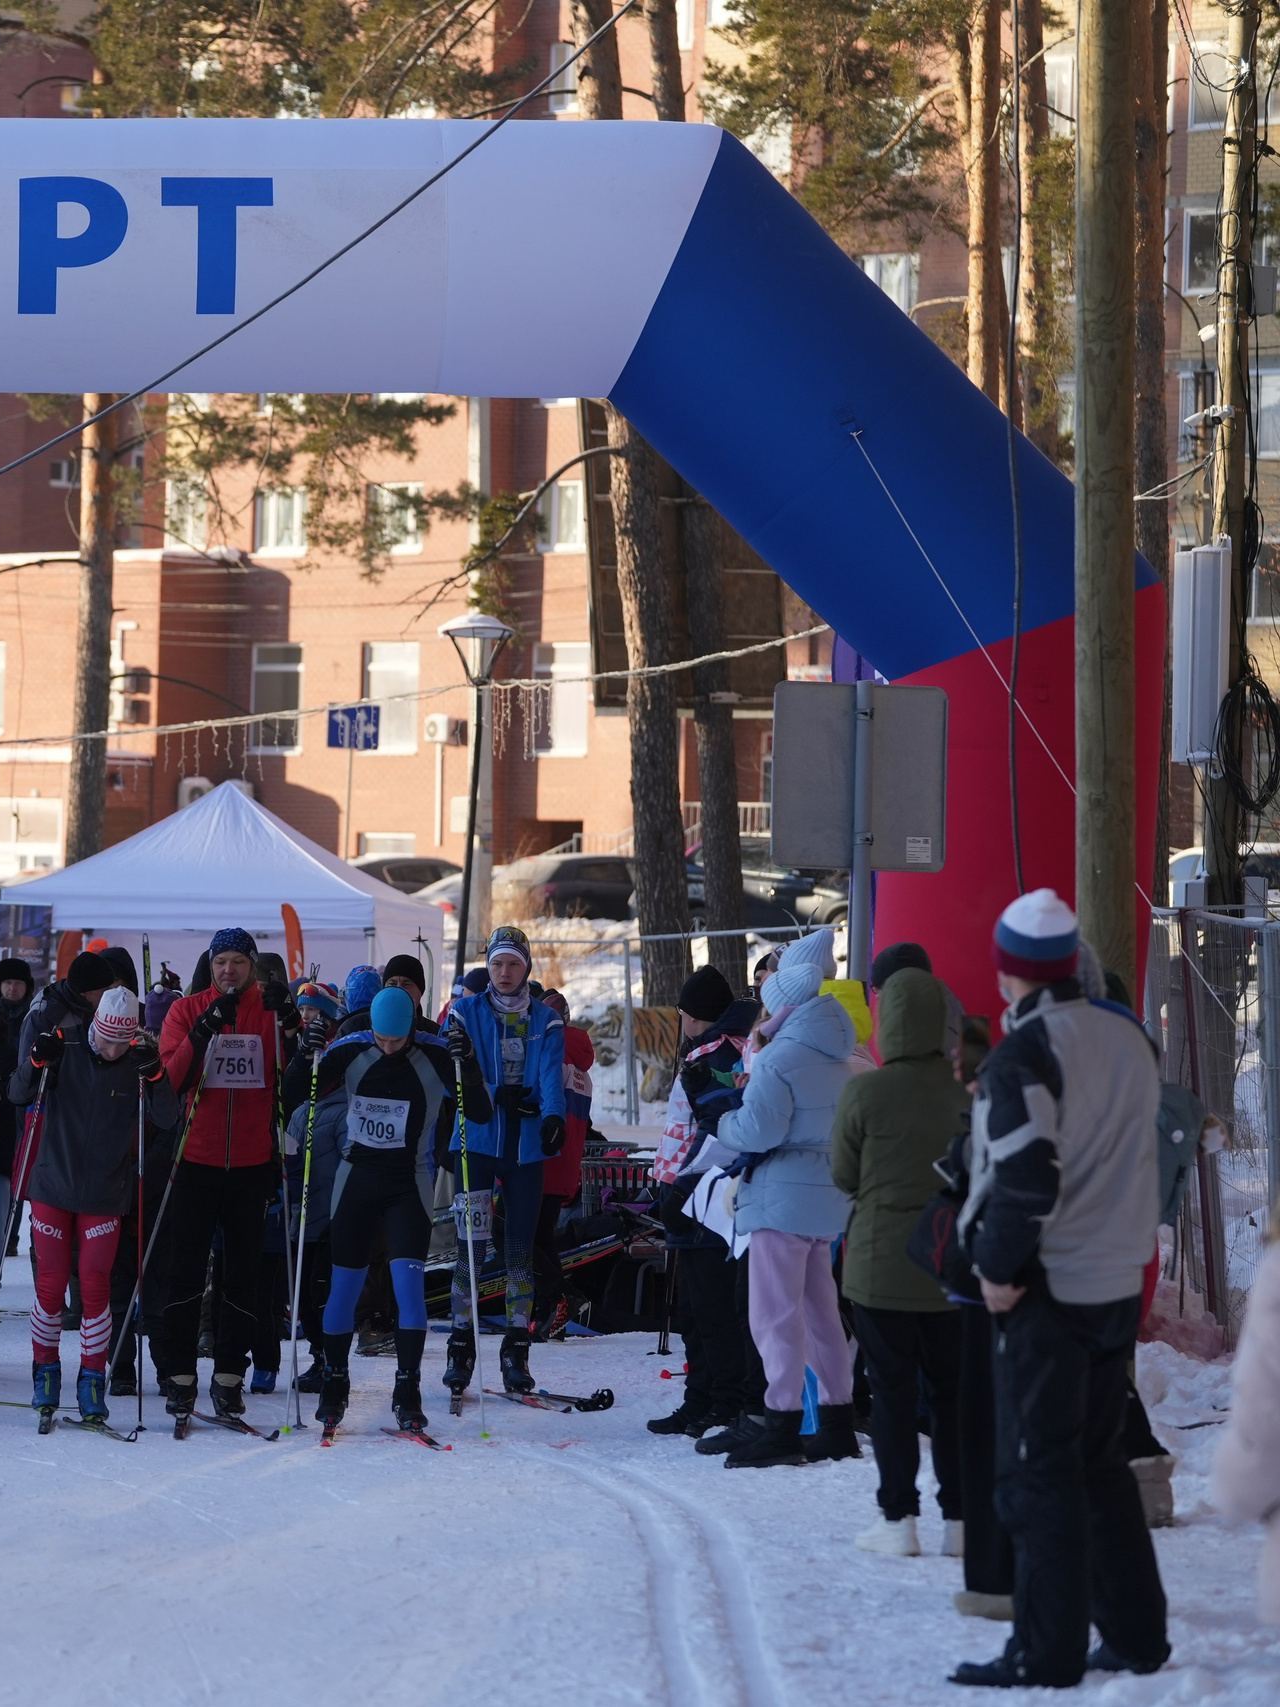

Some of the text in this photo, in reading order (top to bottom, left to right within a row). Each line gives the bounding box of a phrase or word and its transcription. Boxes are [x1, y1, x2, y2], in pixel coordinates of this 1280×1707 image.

[104, 1013, 138, 1027] LUKOIL
[215, 1057, 254, 1075] 7561
[359, 1116, 395, 1139] 7009
[32, 1214, 62, 1240] UKOIL
[85, 1221, 115, 1240] BOSCO
